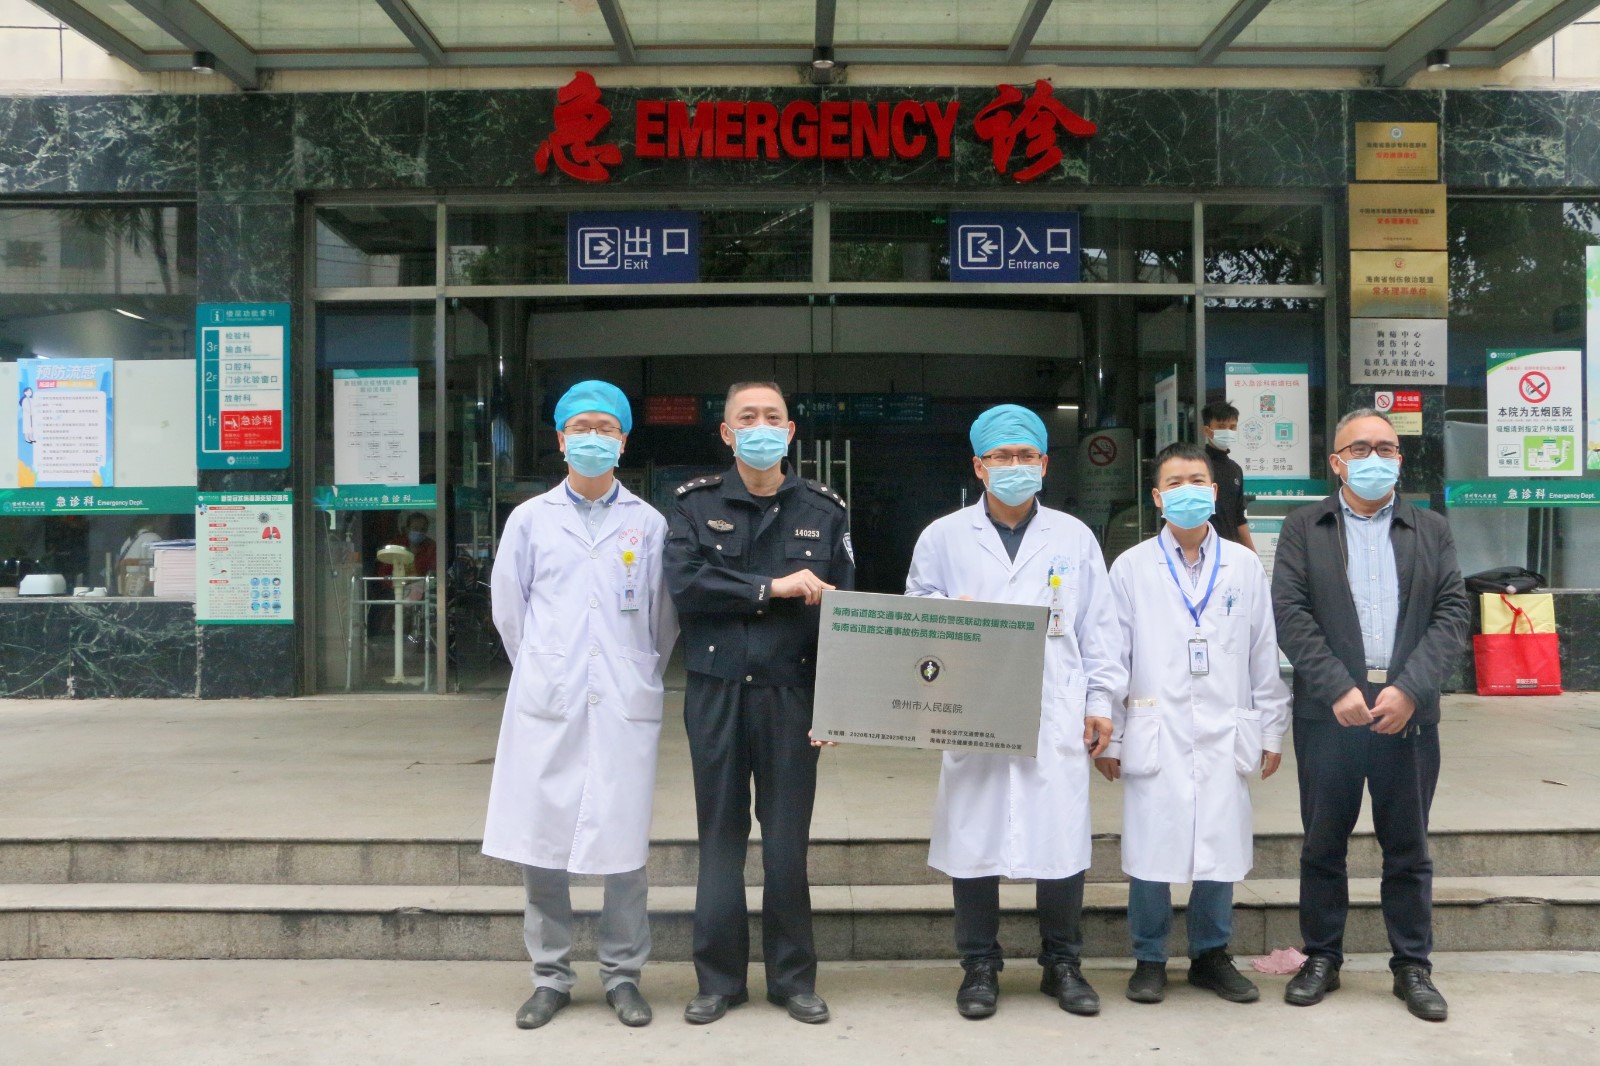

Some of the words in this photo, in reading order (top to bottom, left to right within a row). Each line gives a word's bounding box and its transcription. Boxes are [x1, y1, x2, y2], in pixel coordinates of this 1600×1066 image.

[534, 71, 622, 183] 急
[635, 100, 961, 160] EMERGENCY
[974, 78, 1098, 183] 诊
[624, 226, 689, 257] 出口
[1008, 226, 1071, 255] 入口
[624, 259, 649, 270] Exit
[1008, 259, 1060, 269] Entrance
[1498, 406, 1572, 417] 本院为无烟医院
[241, 415, 272, 426] 急诊科
[1496, 425, 1575, 433] 吸烟请到指定户外吸烟区
[382, 495, 411, 503] 急诊科
[1508, 488, 1545, 499] 急诊科
[56, 496, 94, 507] 急诊科
[795, 529, 820, 538] 140253
[892, 699, 963, 714] 儋州市人民医院
